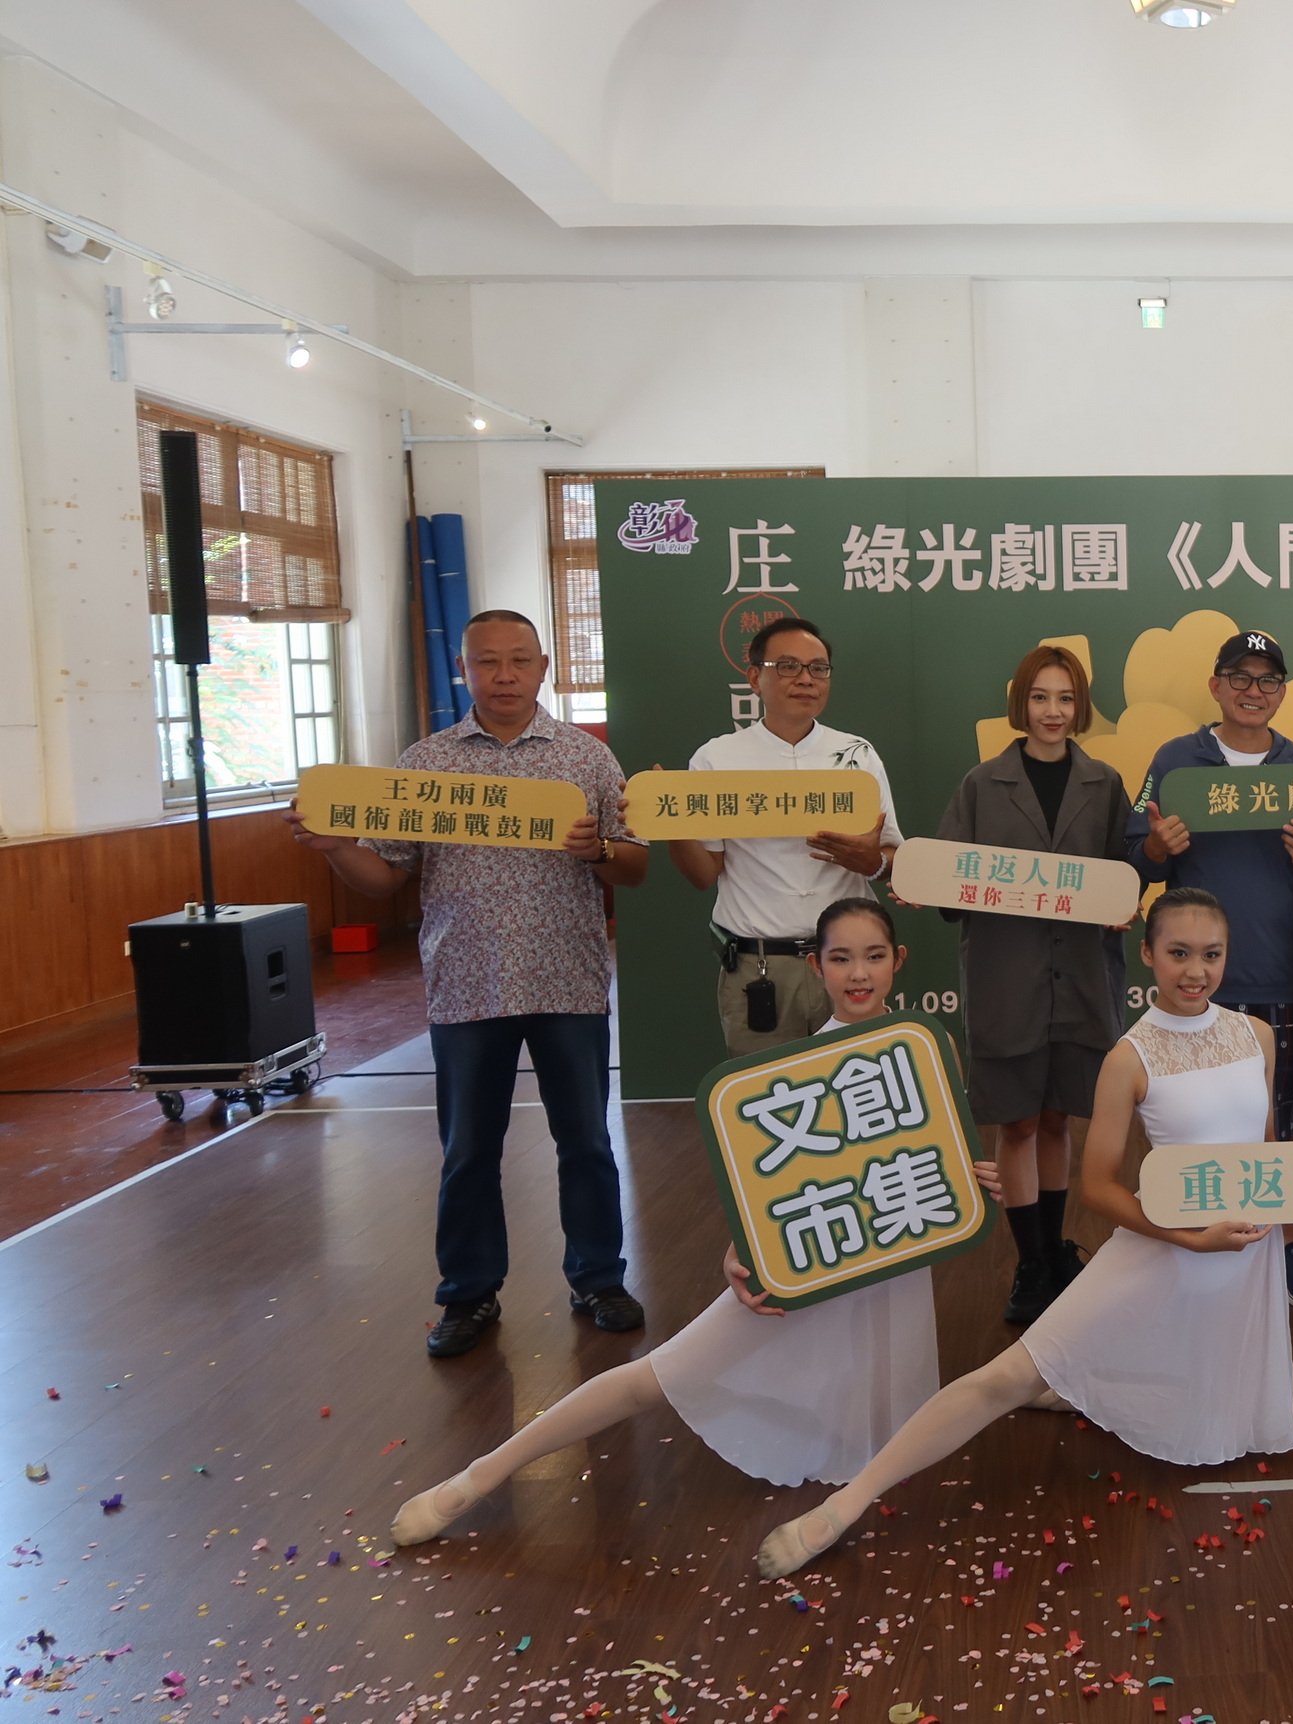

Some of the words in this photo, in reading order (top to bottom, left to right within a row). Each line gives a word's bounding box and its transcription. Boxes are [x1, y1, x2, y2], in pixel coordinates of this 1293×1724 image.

[722, 519, 800, 595] 庄
[1247, 634, 1267, 650] NY
[382, 777, 508, 808] 王功兩廣
[655, 791, 855, 818] 光興閣掌中劇團
[329, 803, 554, 841] 國術龍獅戰鼓團
[952, 850, 1085, 892] 重返人間
[958, 884, 1074, 915] 還你三千萬
[741, 1045, 925, 1173] 文創
[771, 1149, 956, 1269] 市集
